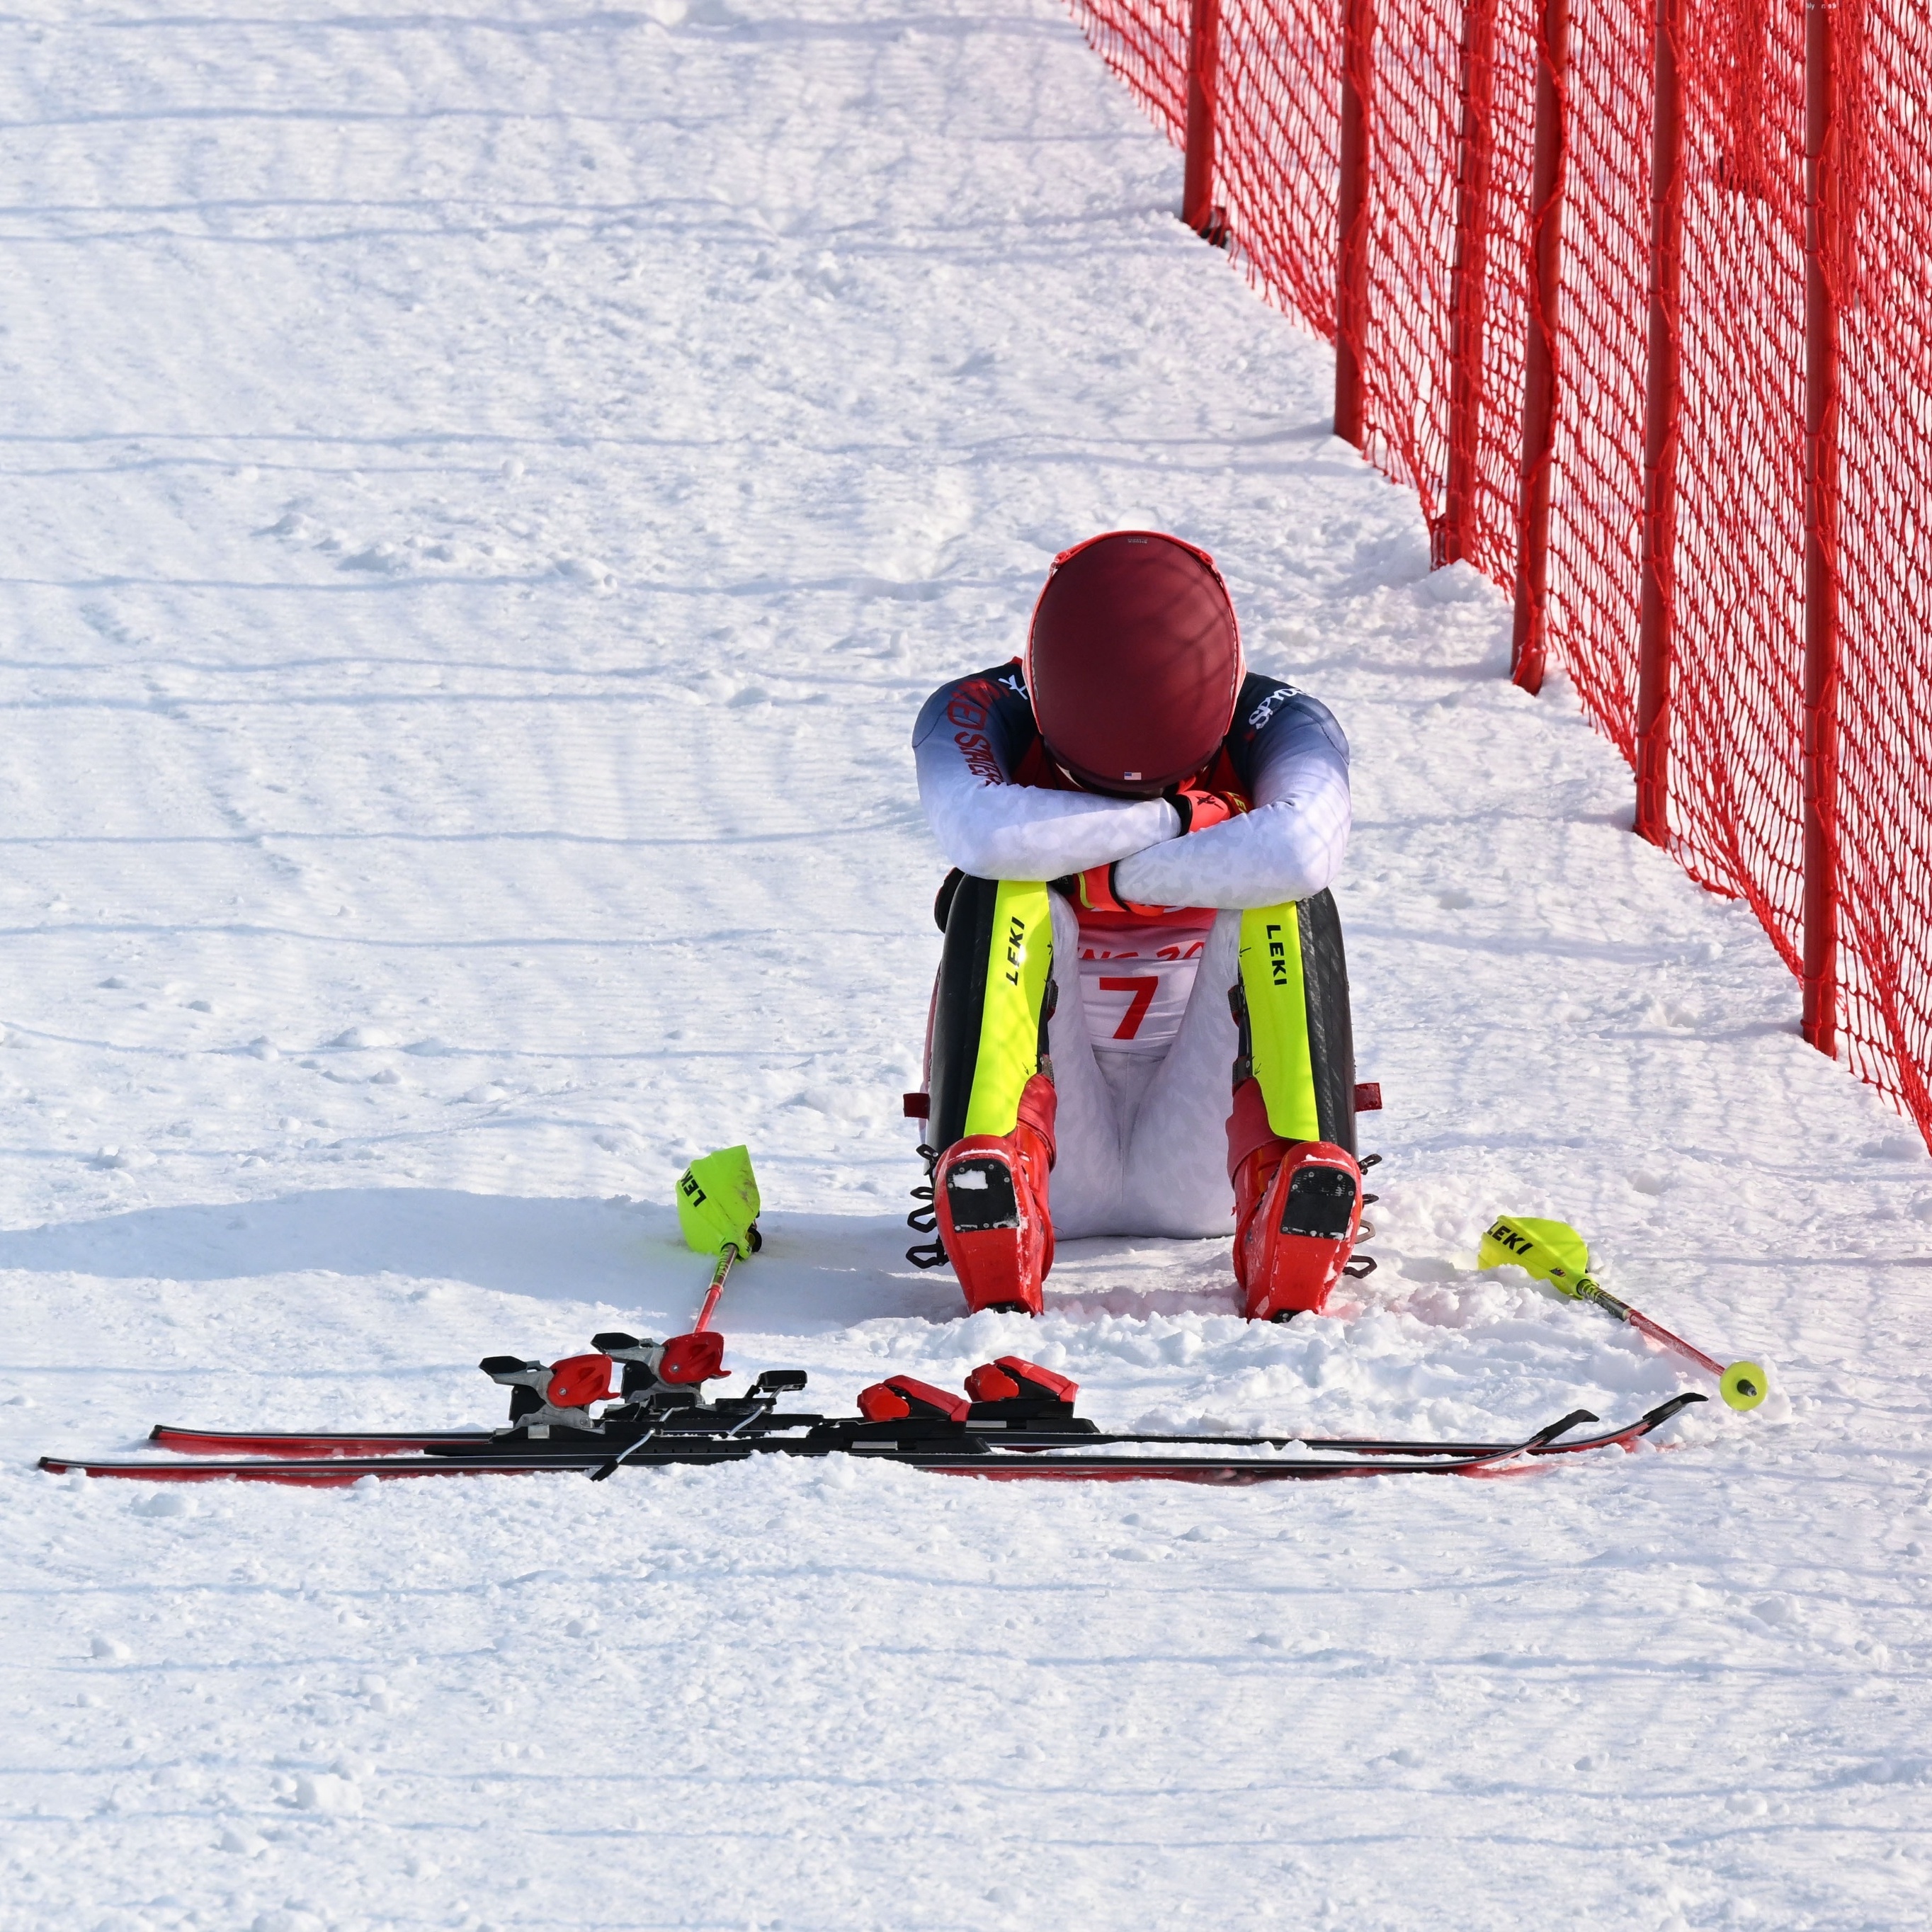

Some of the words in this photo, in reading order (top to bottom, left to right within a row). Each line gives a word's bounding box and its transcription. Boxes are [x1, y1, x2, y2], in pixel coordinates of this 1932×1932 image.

[1006, 916, 1025, 986] LEKI
[1266, 925, 1288, 986] LEKI
[1099, 976, 1159, 1040] 7
[680, 1167, 707, 1208] LEK
[1487, 1221, 1534, 1255] LEKI
